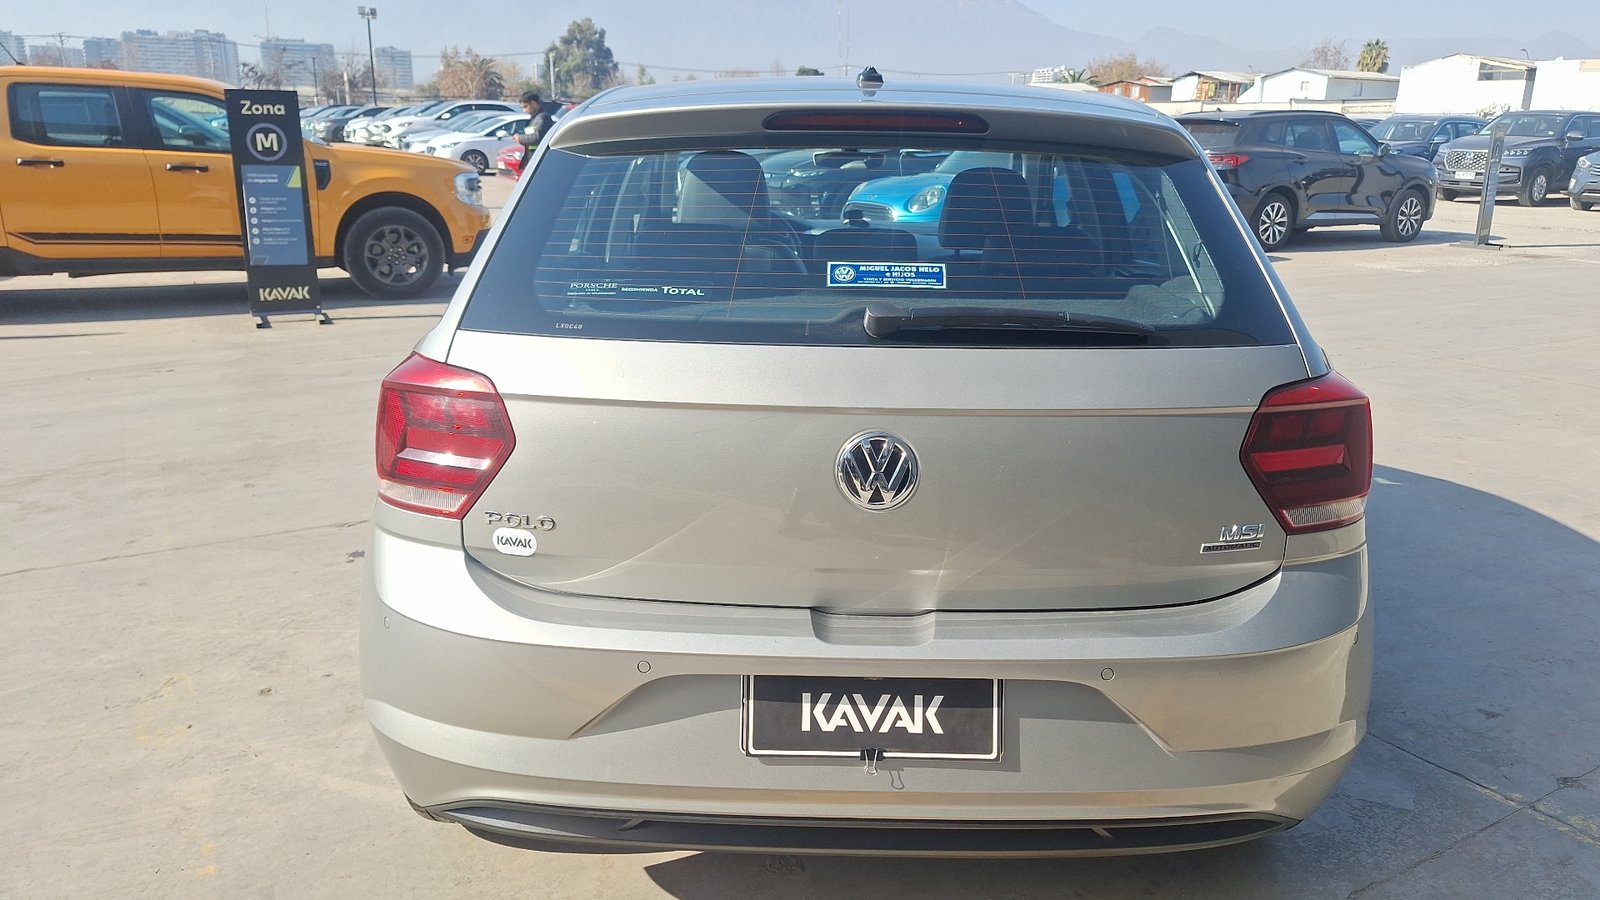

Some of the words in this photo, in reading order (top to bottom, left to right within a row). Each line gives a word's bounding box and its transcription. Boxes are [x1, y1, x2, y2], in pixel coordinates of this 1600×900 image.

[240, 100, 285, 115] Zona
[255, 132, 279, 152] M
[259, 285, 311, 302] KAVAK
[661, 286, 705, 296] TOTAL
[484, 510, 557, 531] POLO
[1219, 523, 1265, 541] MSI
[496, 535, 532, 549] KAVAK
[1204, 542, 1260, 552] AUTOMATIC
[801, 692, 945, 734] KAVAK
